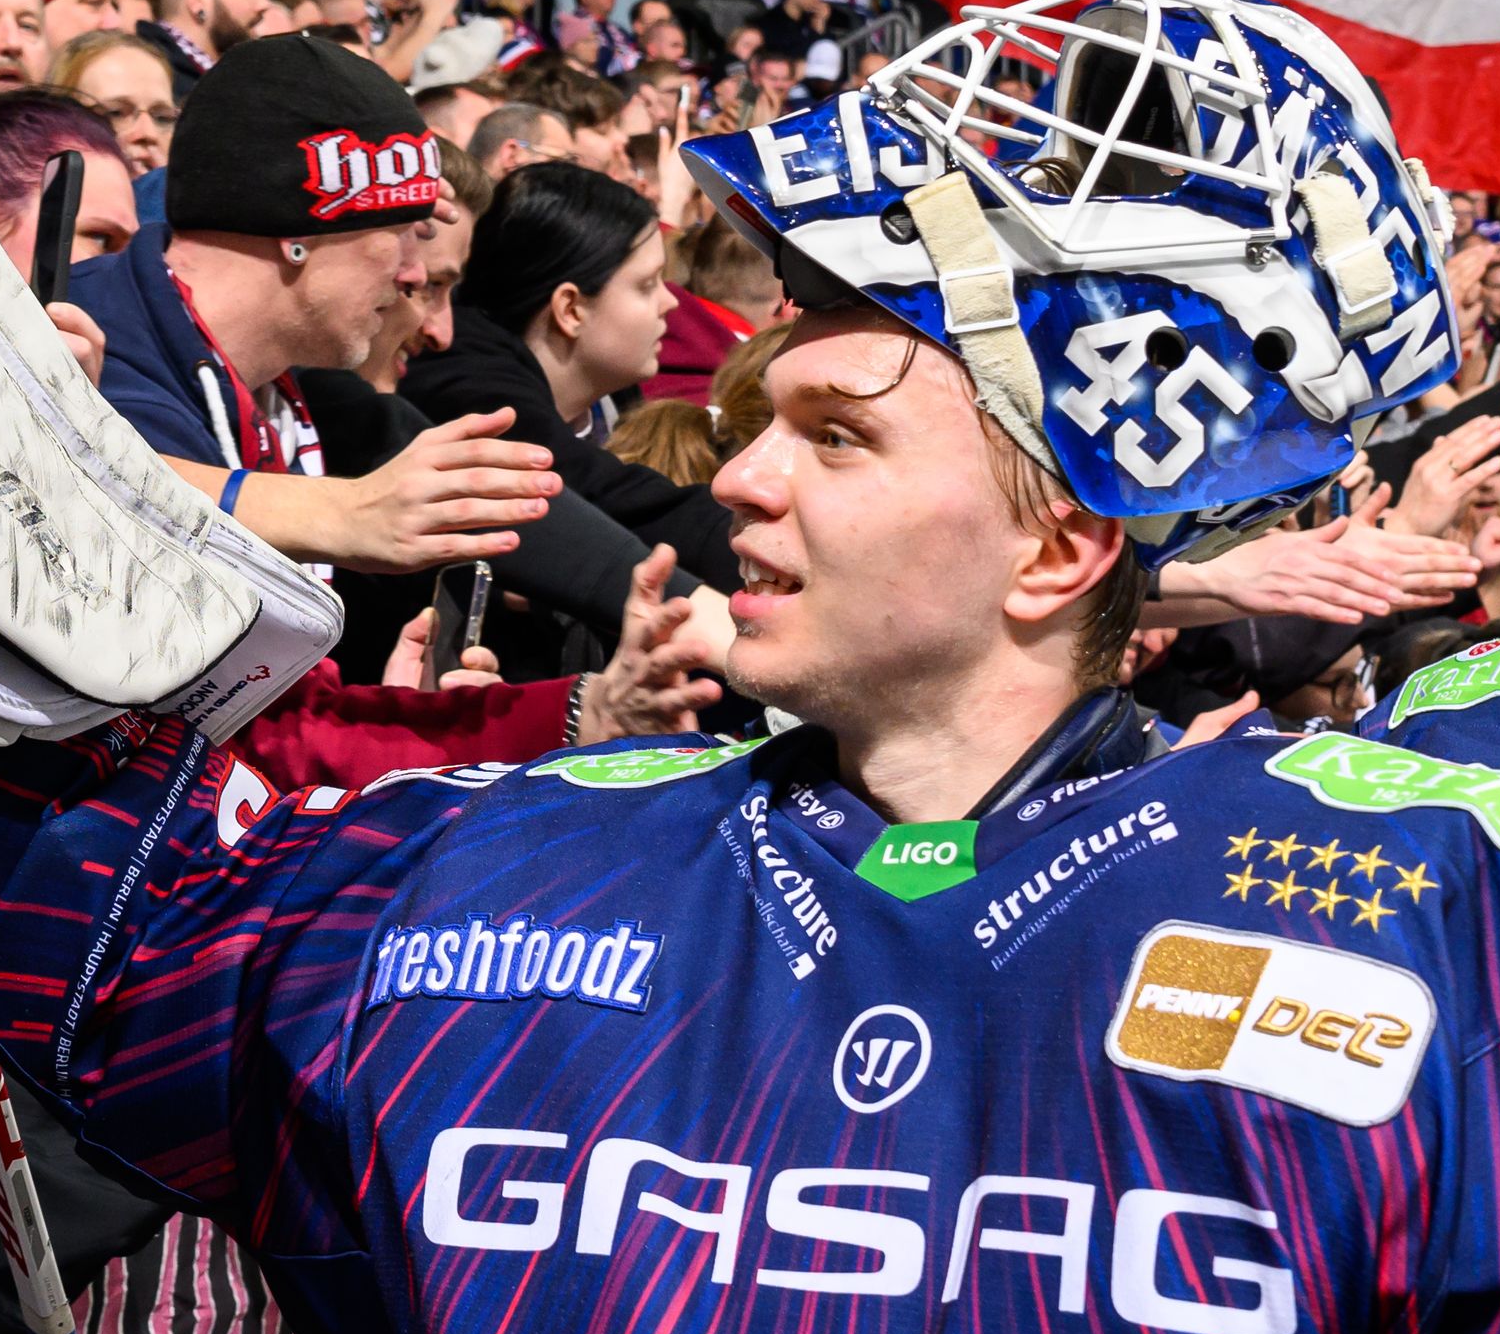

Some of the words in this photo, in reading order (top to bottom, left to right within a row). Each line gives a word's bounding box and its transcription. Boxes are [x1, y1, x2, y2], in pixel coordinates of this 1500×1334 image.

[1054, 308, 1254, 489] 45
[174, 678, 219, 716] ANCICK
[1434, 689, 1463, 702] 1921
[605, 767, 648, 781] 1921
[1369, 785, 1421, 806] 1921
[140, 773, 189, 861] HAUPTSTADT
[880, 838, 959, 868] LIGO
[972, 800, 1169, 950] structure
[109, 863, 141, 924] BERLIN
[67, 932, 112, 1031] HAUPTSTADT
[370, 917, 661, 1011] freshfoodz
